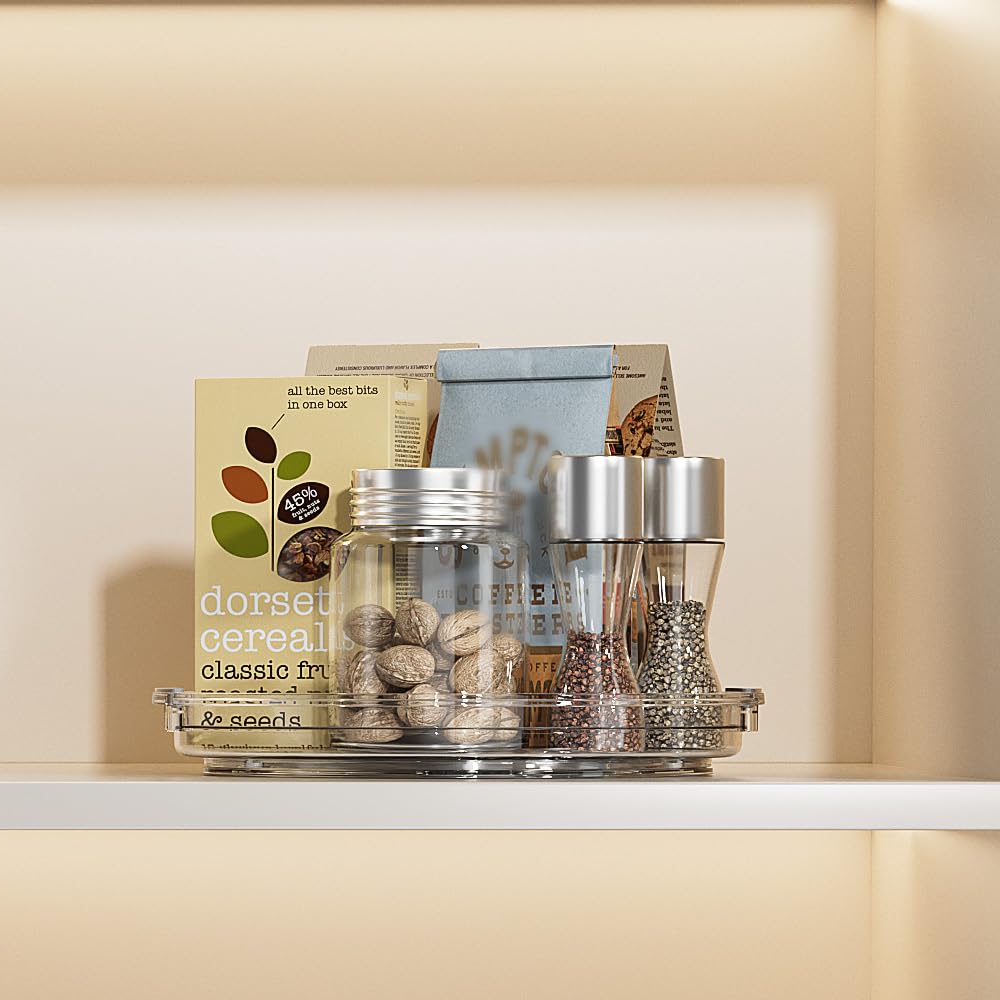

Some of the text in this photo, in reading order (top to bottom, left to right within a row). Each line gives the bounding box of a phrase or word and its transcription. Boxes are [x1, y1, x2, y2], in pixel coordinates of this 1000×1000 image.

[287, 385, 379, 396] all the best bits
[287, 399, 348, 410] in one box
[284, 485, 318, 512] 45%
[200, 585, 331, 616] dorset
[201, 660, 289, 681] classic
[230, 711, 302, 731] seeds
